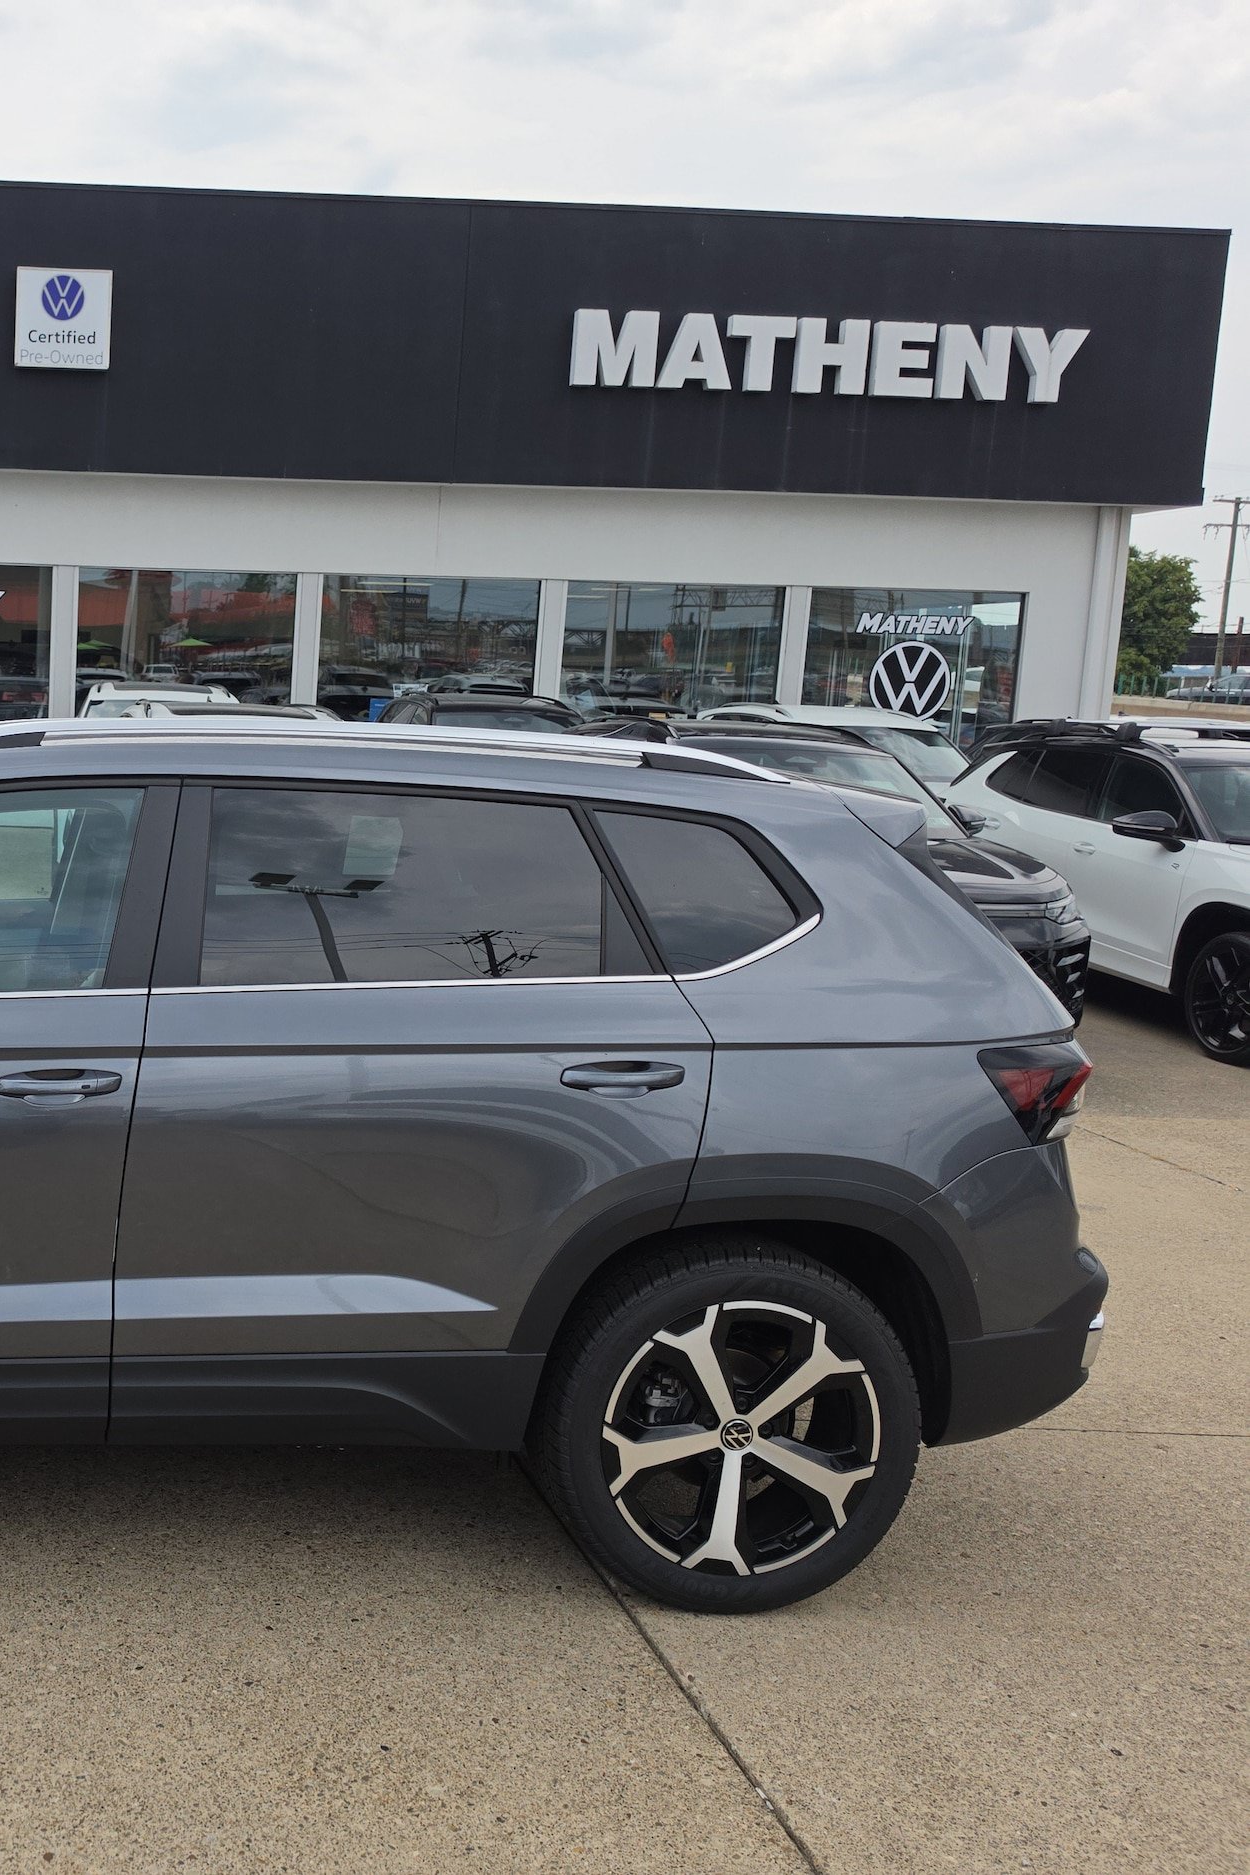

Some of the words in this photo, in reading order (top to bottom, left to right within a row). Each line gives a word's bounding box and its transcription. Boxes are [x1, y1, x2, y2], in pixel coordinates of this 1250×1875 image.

[28, 329, 96, 344] Certified
[19, 348, 104, 365] Pre-Owned
[569, 308, 1091, 403] MATHENY
[855, 612, 974, 635] MATHENY
